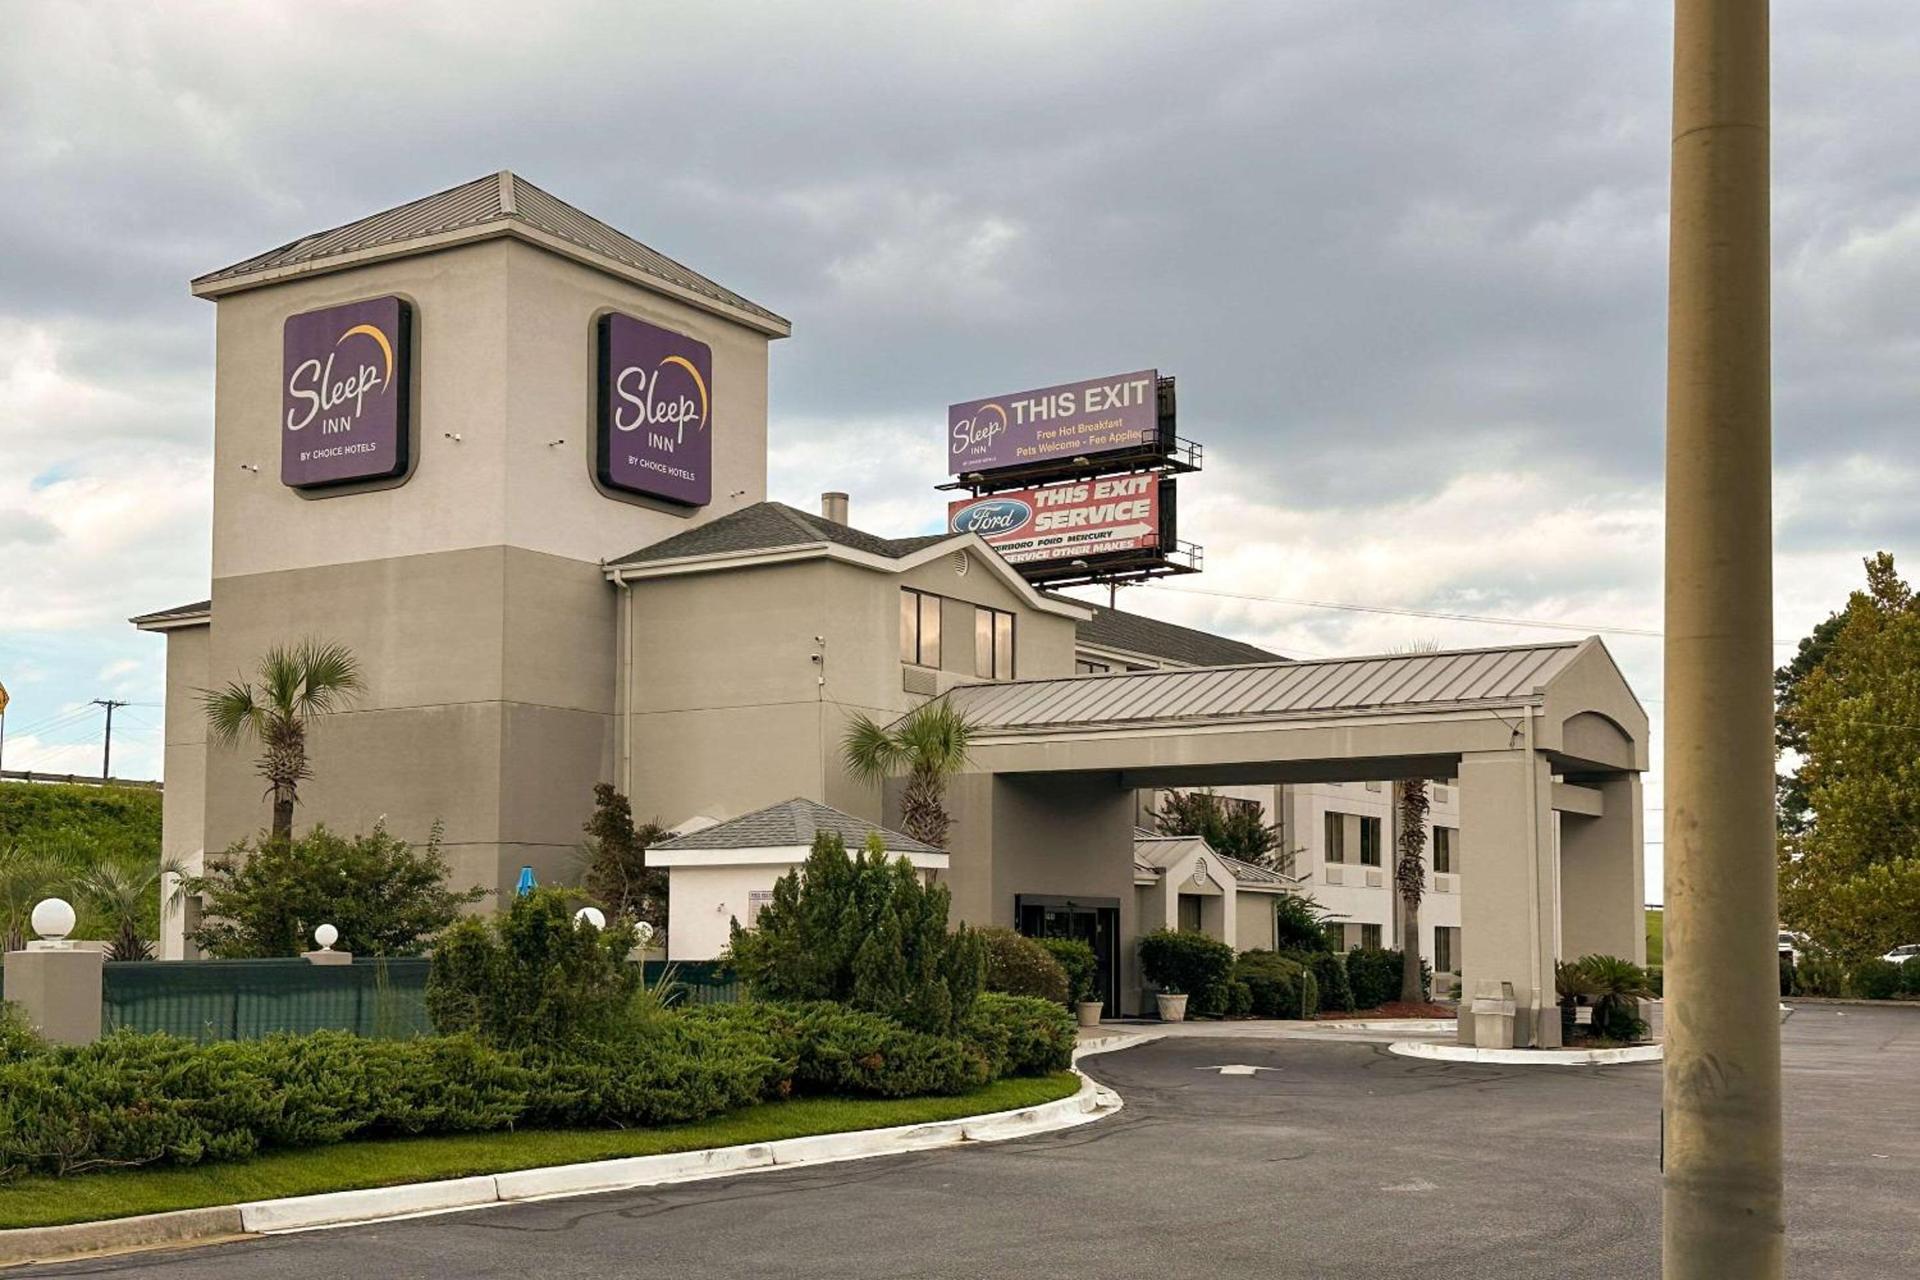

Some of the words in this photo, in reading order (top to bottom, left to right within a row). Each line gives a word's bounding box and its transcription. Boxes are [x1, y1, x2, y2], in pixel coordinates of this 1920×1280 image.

[287, 352, 382, 431] Sleep
[1011, 392, 1076, 425] THIS
[1085, 380, 1149, 413] EXIT
[615, 366, 699, 444] Sleep
[322, 416, 351, 434] INN
[952, 417, 1001, 454] Sleep
[1036, 429, 1057, 441] Free
[1059, 425, 1076, 437] Hot
[1078, 417, 1123, 434] Breakfast
[300, 451, 311, 462] BY
[312, 446, 343, 459] CHOICE
[345, 442, 376, 455] HOTELS
[648, 432, 674, 453] INN
[970, 445, 987, 455] INN
[1016, 446, 1037, 457] Pets
[1038, 438, 1081, 454] Welcome
[1089, 434, 1107, 446] Fee
[628, 455, 639, 466] BY
[639, 458, 667, 474] CHOICE
[668, 467, 696, 481] HOTELS
[1034, 484, 1089, 508] THIS
[1093, 475, 1153, 498] EXIT
[968, 505, 1014, 530] Ford
[1035, 499, 1151, 532] SERVICE
[993, 541, 1034, 552] ERBORO
[1067, 531, 1113, 542] MERCURY
[1052, 543, 1091, 557] OTHER
[1093, 540, 1135, 552] MAKES
